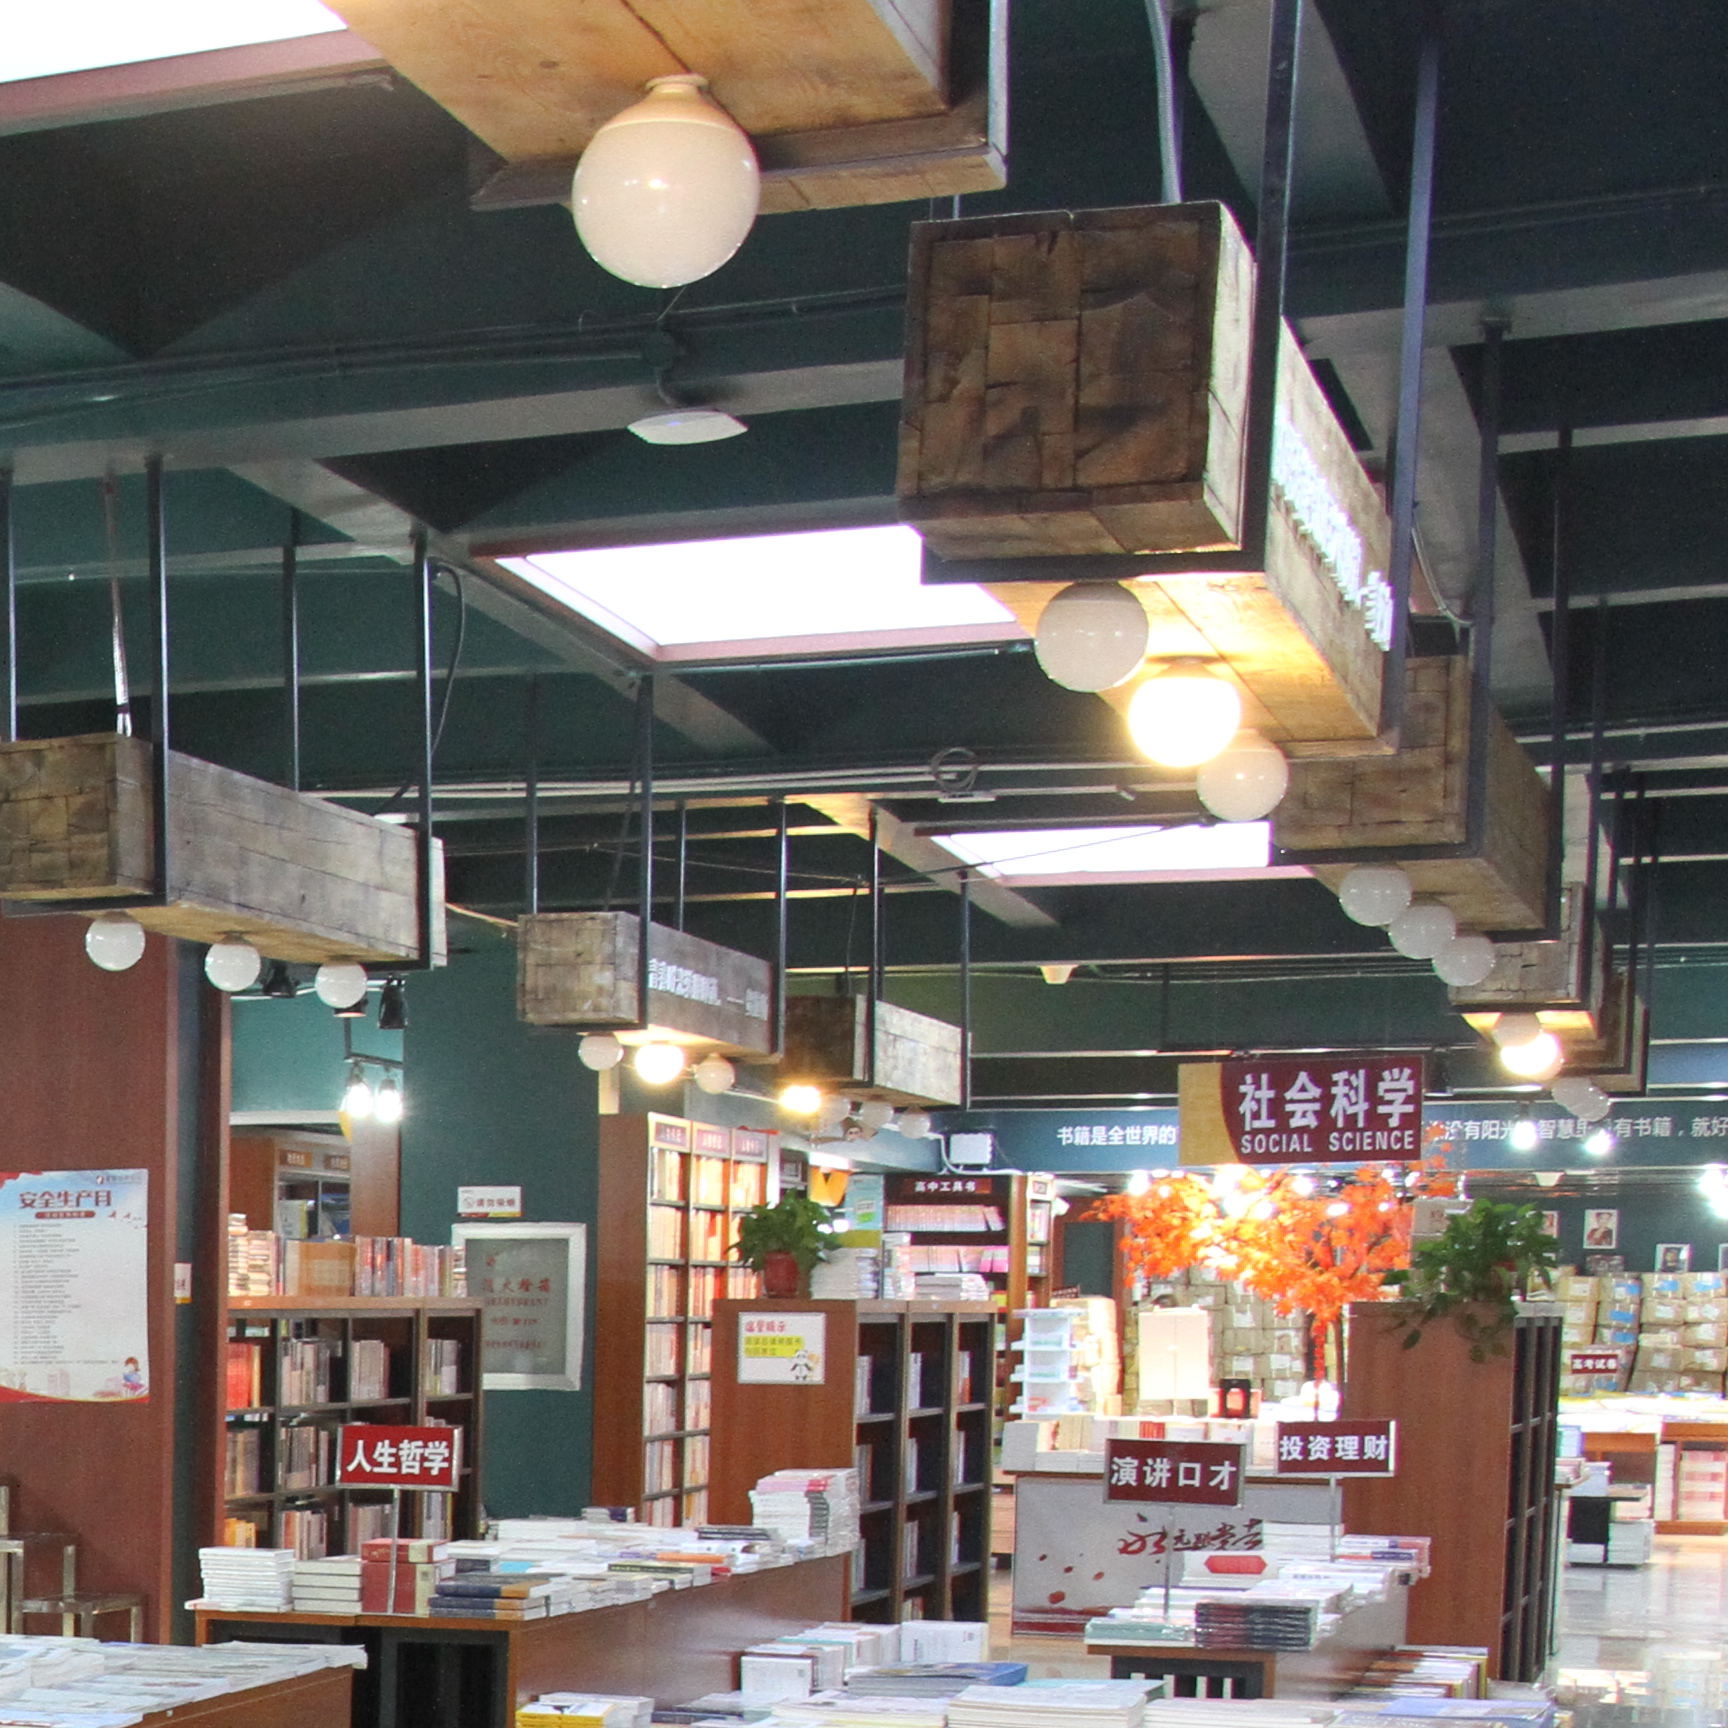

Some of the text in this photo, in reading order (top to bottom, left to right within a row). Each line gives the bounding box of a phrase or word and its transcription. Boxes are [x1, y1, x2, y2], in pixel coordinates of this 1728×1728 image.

[1239, 1068, 1417, 1132] 社会科学
[1056, 1125, 1178, 1148] 书籍是全世界的
[1241, 1129, 1416, 1154] SOCIAL SCIENCE
[346, 1438, 451, 1478] 人生哲学
[1280, 1434, 1390, 1463] 投资理财
[1110, 1456, 1239, 1491] 演讲口才
